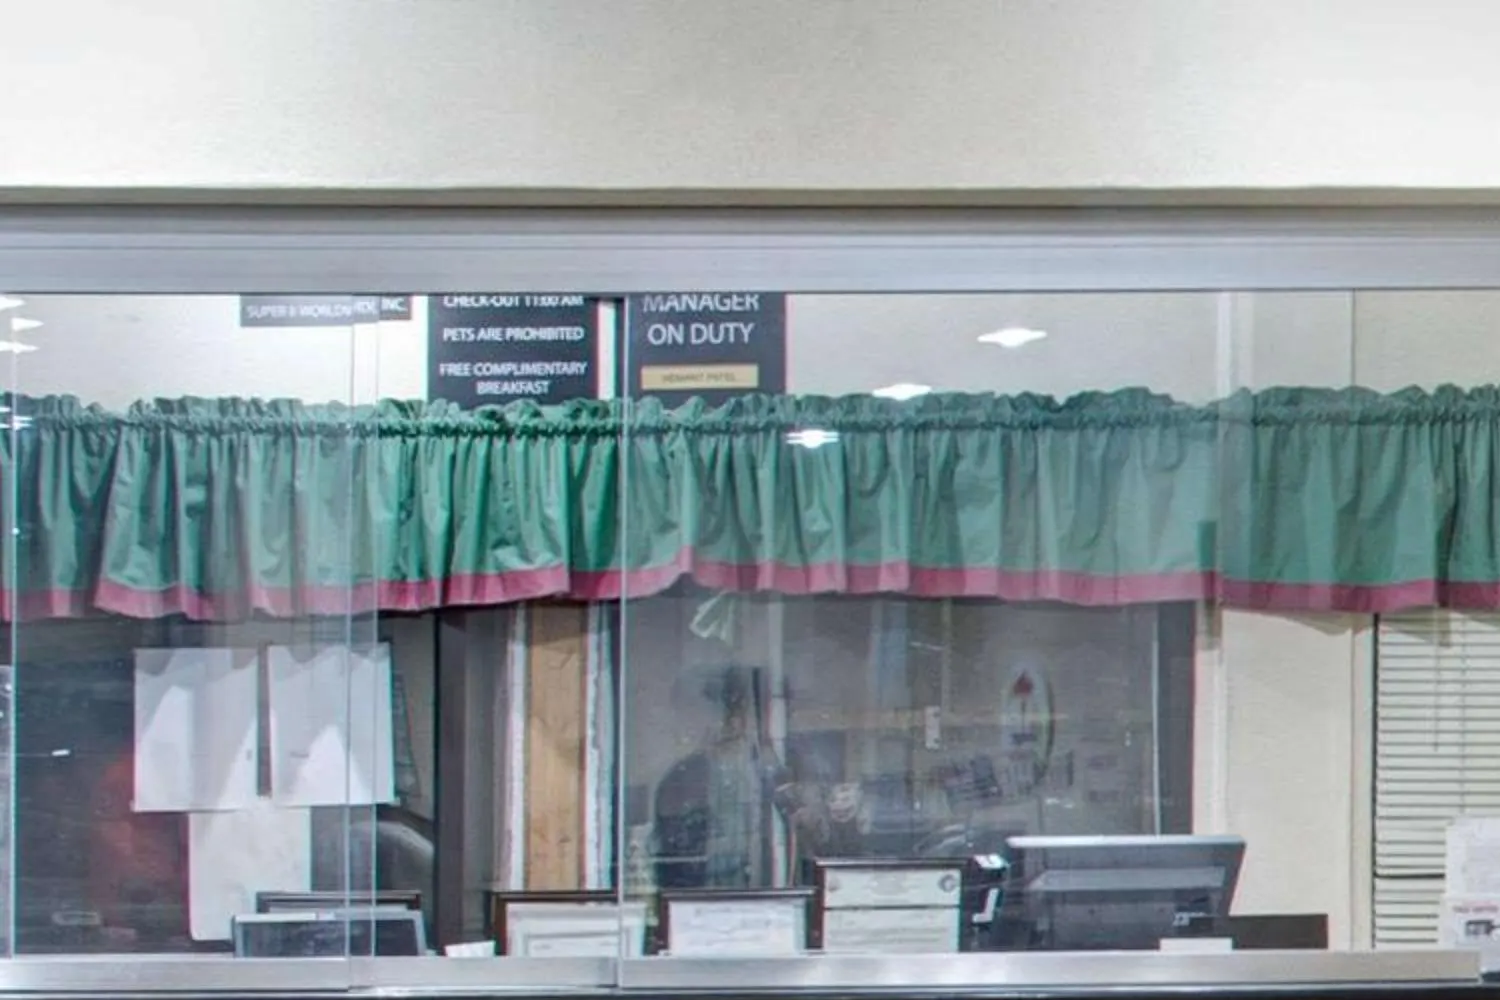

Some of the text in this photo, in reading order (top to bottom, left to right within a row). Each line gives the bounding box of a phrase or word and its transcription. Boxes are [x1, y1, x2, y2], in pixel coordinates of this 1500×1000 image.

[643, 293, 760, 313] MANAGER
[443, 326, 585, 341] PETS ARE PROHIBITED
[647, 322, 755, 345] ON DUTY
[439, 361, 588, 376] FREE COMPLIMENTARY
[475, 380, 551, 395] BREAKFAST
